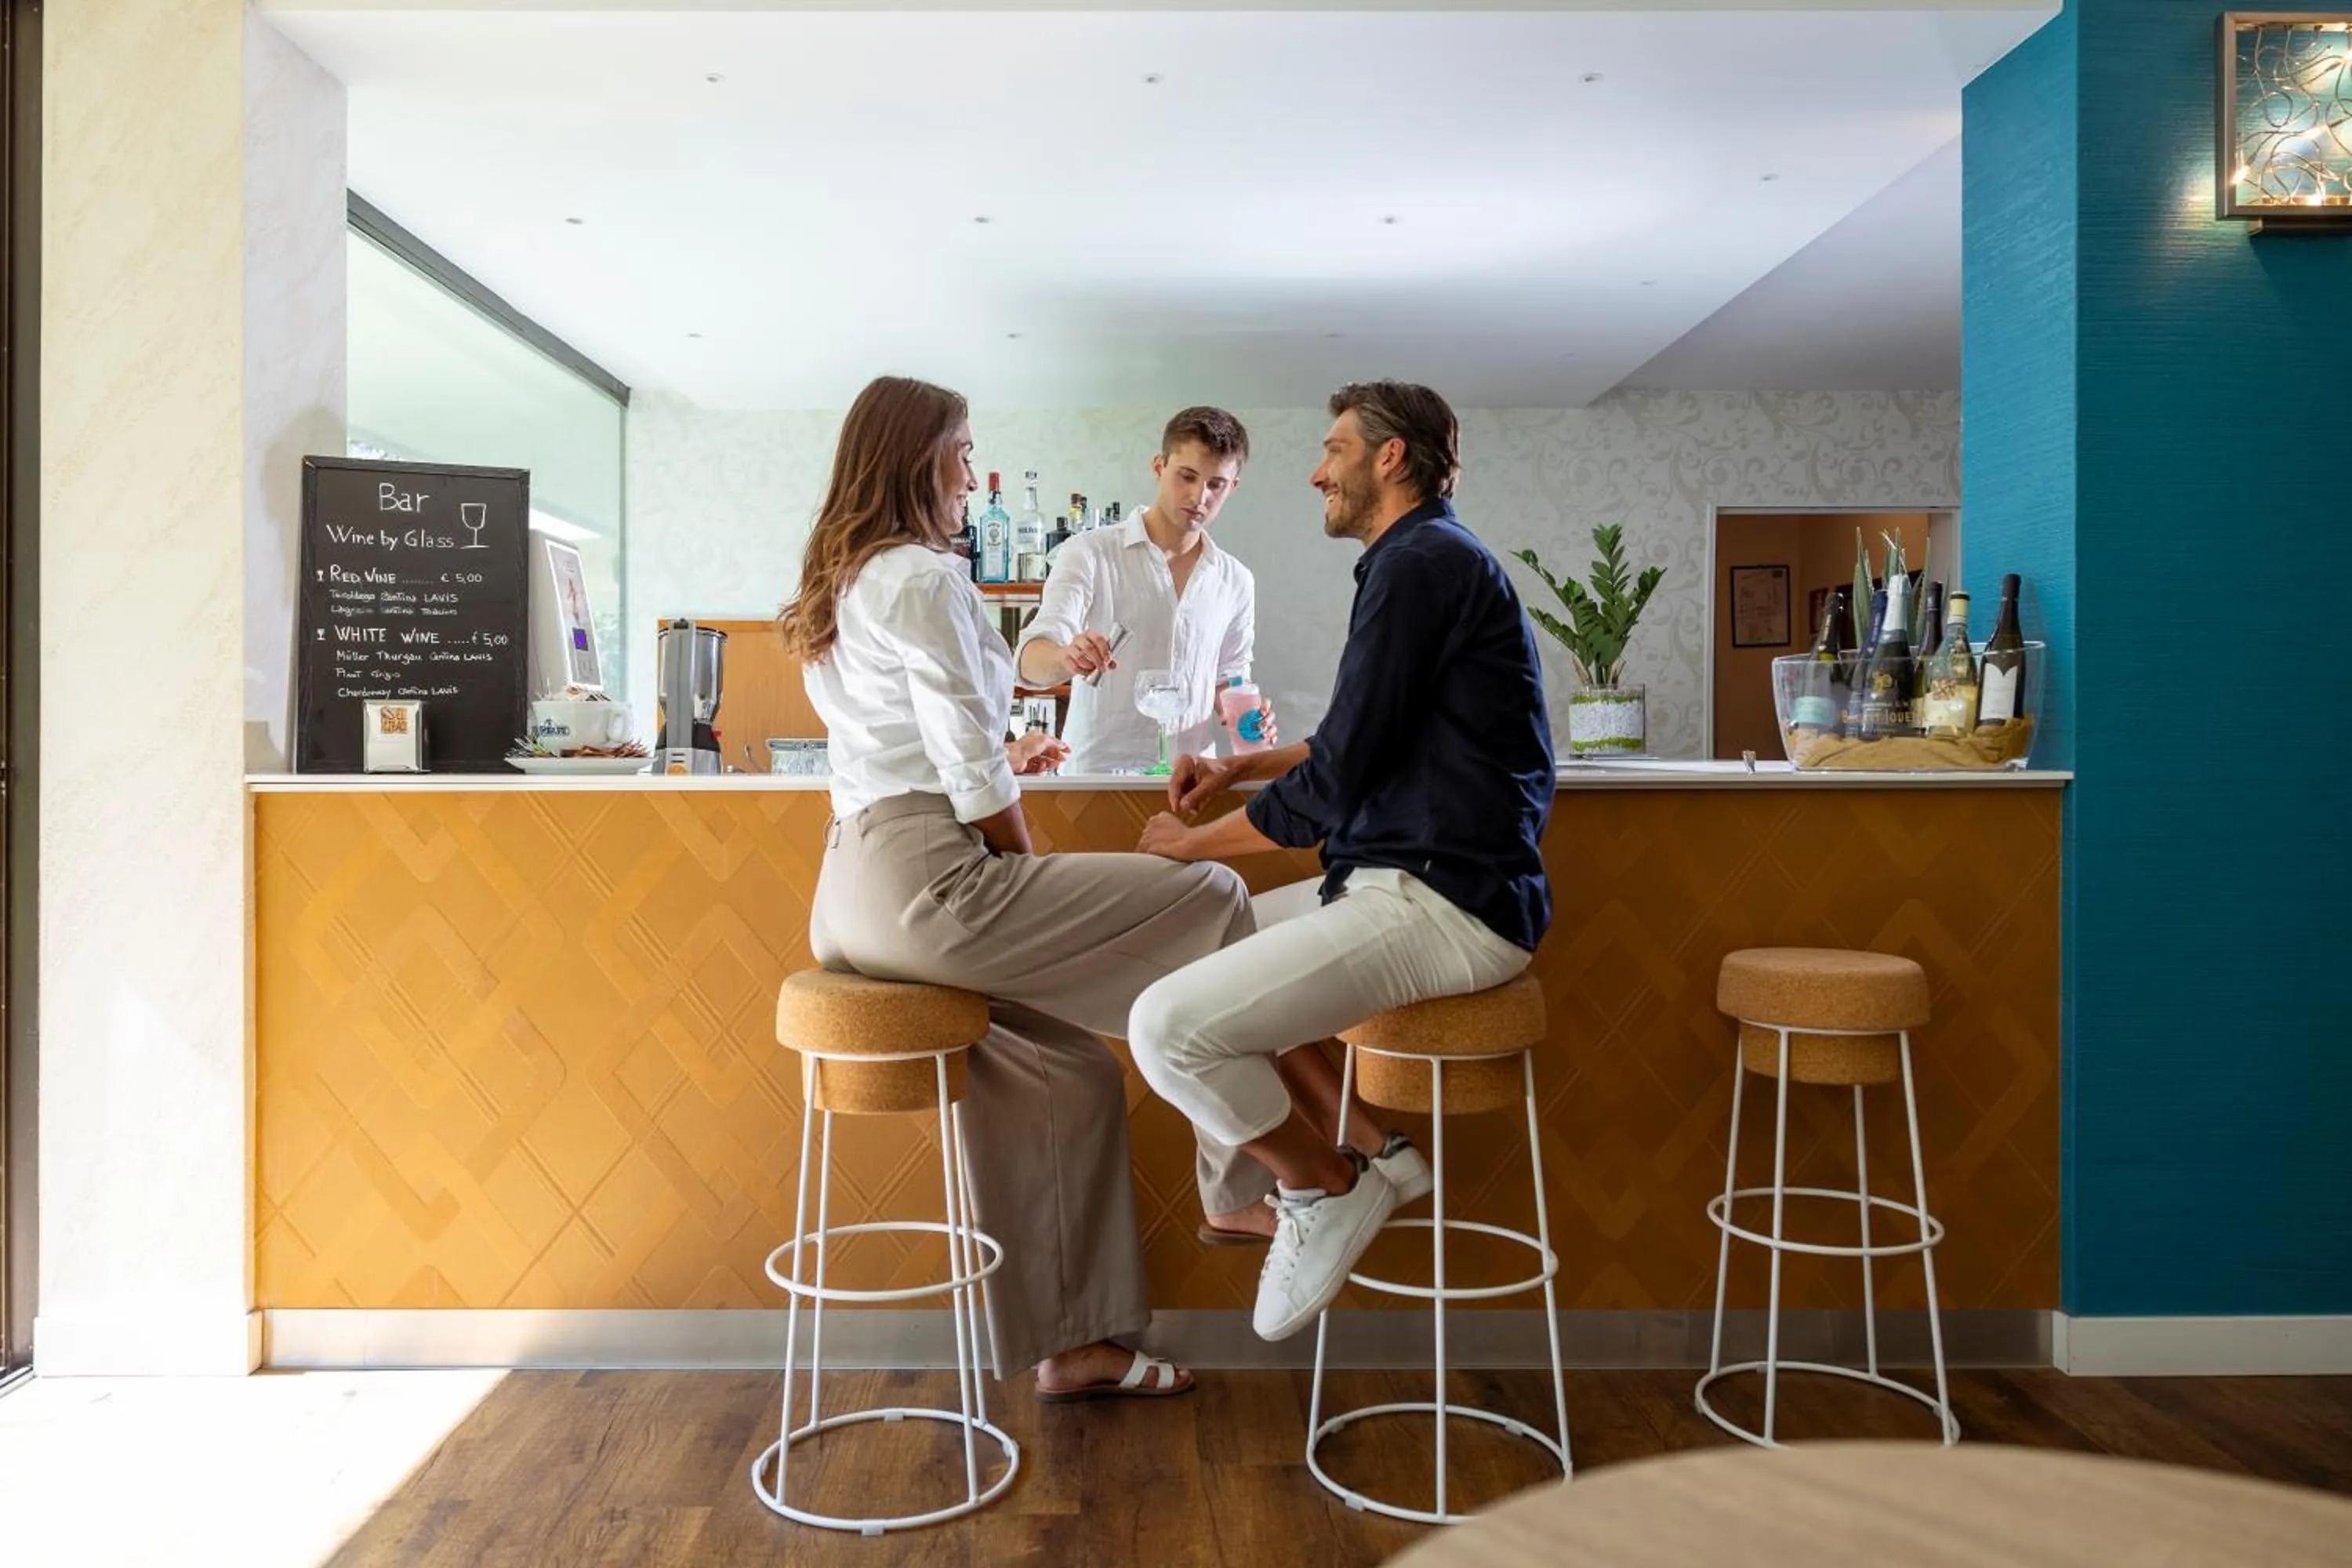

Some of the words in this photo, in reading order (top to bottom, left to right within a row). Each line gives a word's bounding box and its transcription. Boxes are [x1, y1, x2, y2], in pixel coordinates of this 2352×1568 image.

[379, 482, 430, 512] Bar
[326, 524, 375, 545] Wine
[380, 529, 398, 550] by
[404, 527, 455, 548] Glass
[330, 564, 361, 583] RED
[456, 573, 483, 584] 5,00
[334, 625, 387, 642] WHITE
[401, 627, 441, 644] WINE
[482, 633, 509, 647] 5,00
